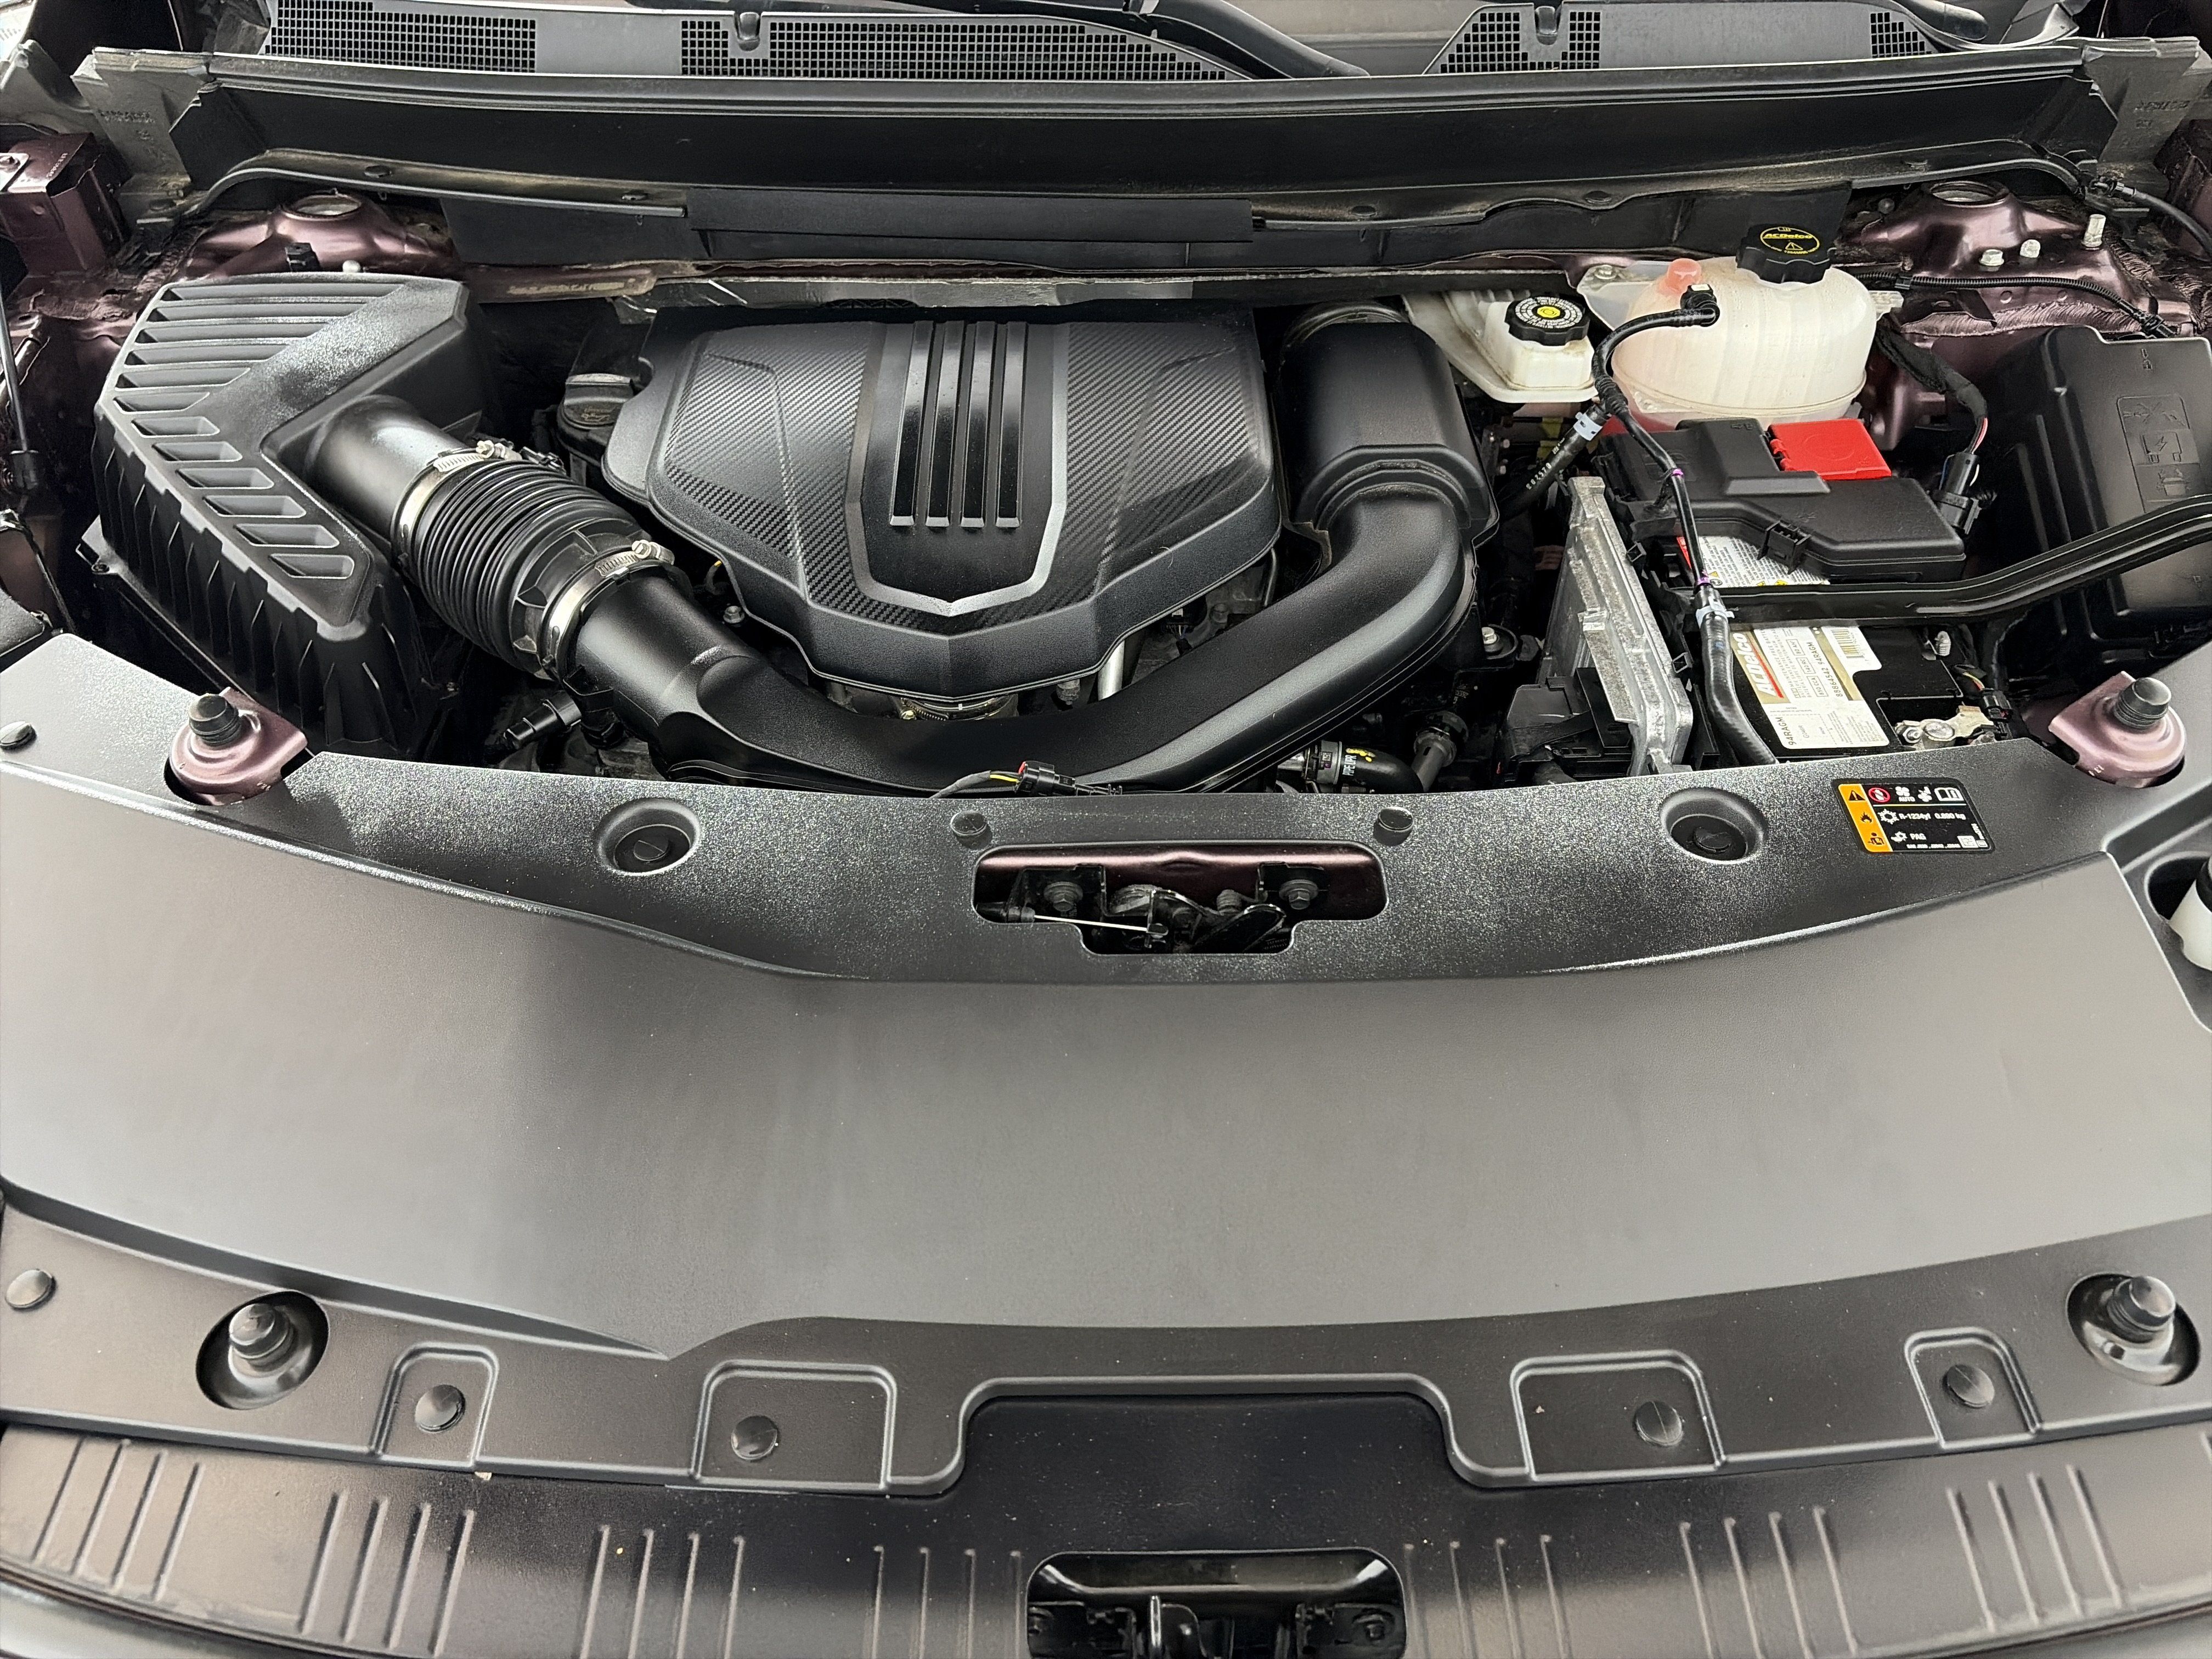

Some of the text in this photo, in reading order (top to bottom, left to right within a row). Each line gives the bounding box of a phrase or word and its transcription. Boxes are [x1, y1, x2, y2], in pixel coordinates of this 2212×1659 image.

[1733, 633, 1777, 696] ACDelco
[1806, 642, 1825, 665] 94RAGM
[1811, 678, 1819, 686] CCA
[1821, 667, 1843, 697] 88864542
[1775, 717, 1797, 746] 94RAGM
[1342, 764, 1356, 776] PIPE
[1898, 812, 1931, 821] R-1234yf
